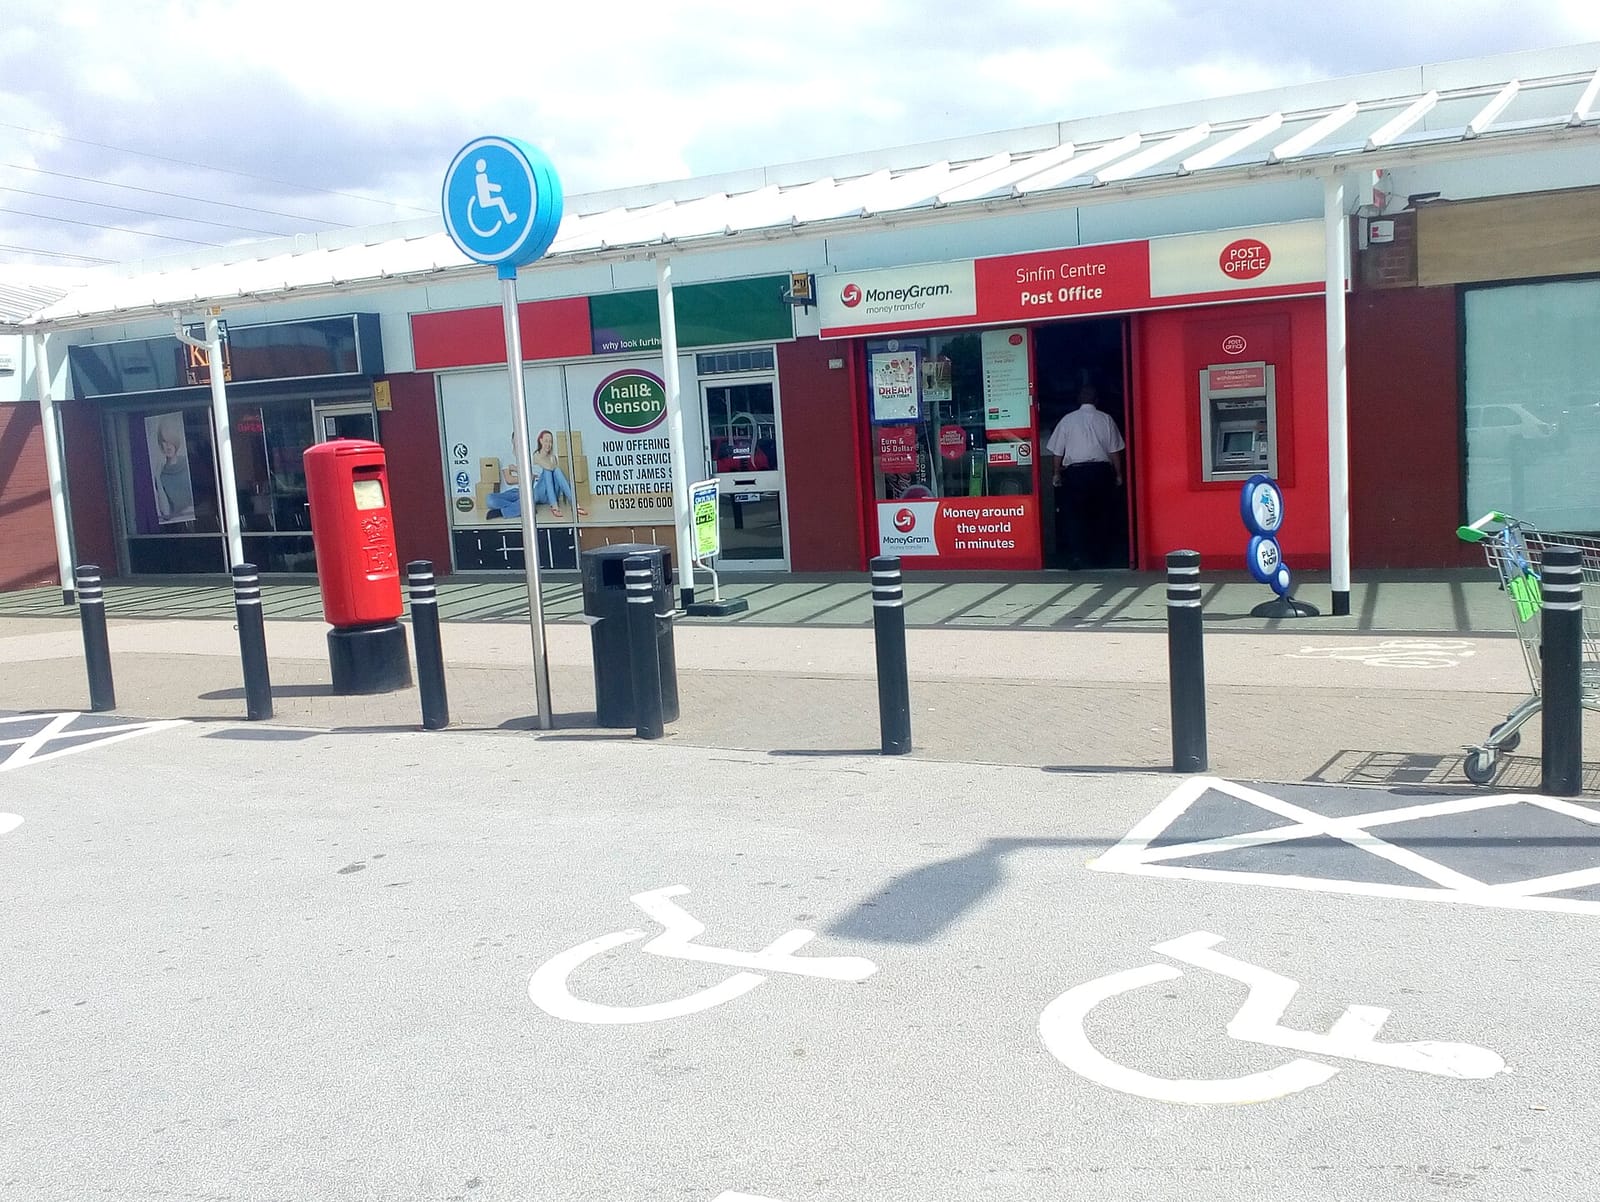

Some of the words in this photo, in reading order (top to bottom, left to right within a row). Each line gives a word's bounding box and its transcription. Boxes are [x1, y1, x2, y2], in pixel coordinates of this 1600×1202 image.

[1230, 246, 1262, 260] POST
[1224, 258, 1266, 273] OFFICE
[1016, 266, 1055, 283] Sinfin
[1060, 263, 1106, 279] Centre
[1021, 290, 1053, 306] Post
[1058, 285, 1102, 302] Office
[866, 305, 893, 314] money
[893, 301, 926, 312] transfer
[602, 341, 619, 351] why
[620, 340, 638, 348] look
[639, 337, 661, 347] furth
[610, 383, 652, 399] hall&
[879, 386, 913, 395] DREAM
[604, 400, 661, 414] benson
[603, 440, 624, 453] NOW
[626, 438, 670, 452] OFFERING
[892, 444, 914, 452] Dollar
[597, 455, 613, 468] ALL
[615, 454, 634, 466] OUR
[595, 469, 621, 482] FROM
[623, 469, 634, 480] ST
[636, 467, 666, 480] JAMES
[596, 484, 615, 496] CITY
[617, 482, 651, 495] CENTRE
[609, 497, 636, 510] 01332
[638, 497, 654, 509] 606
[656, 496, 673, 508] 000
[943, 507, 980, 519] Money
[982, 505, 1025, 517] around
[956, 522, 977, 533] the
[978, 522, 1011, 533] world
[882, 535, 930, 545] MoneyGram
[955, 538, 966, 549] in
[967, 538, 1015, 549] minutes
